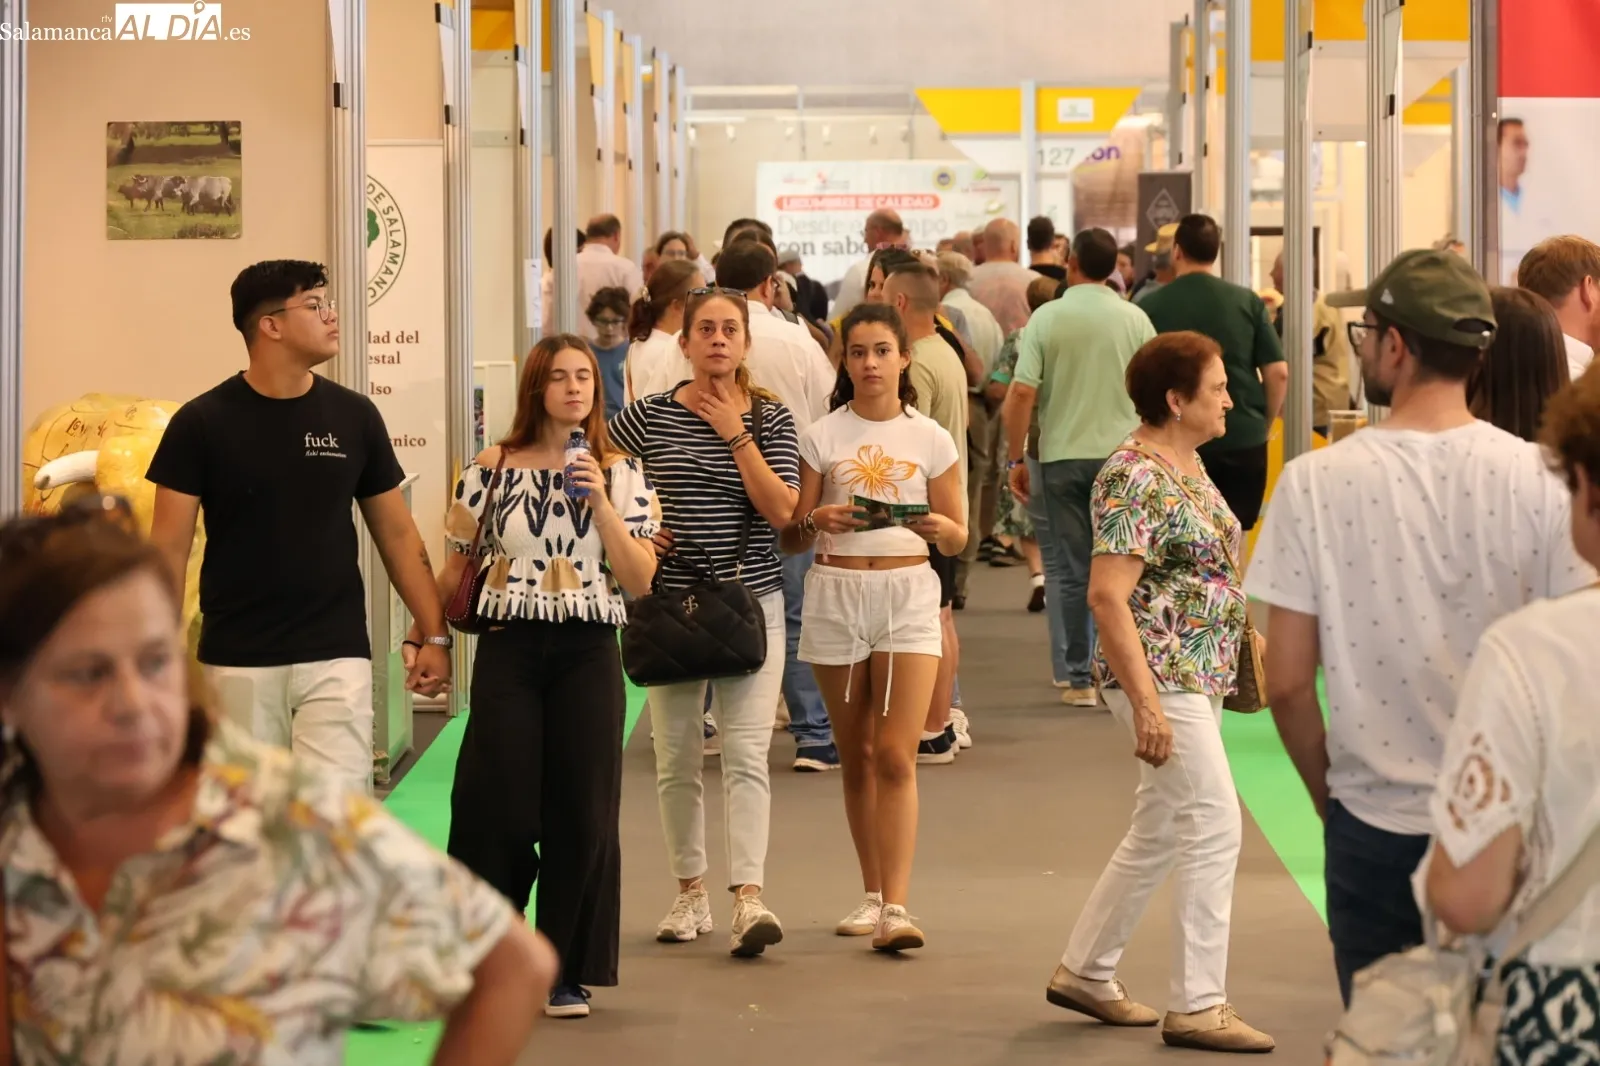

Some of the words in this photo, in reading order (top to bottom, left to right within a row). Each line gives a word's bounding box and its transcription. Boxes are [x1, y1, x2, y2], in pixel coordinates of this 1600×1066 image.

[1036, 147, 1076, 166] 127
[1087, 145, 1121, 162] on
[876, 195, 933, 209] CALIDAD
[778, 215, 844, 235] Desde
[368, 205, 403, 299] SALAMANC
[778, 241, 815, 256] con
[822, 236, 868, 256] sabo
[395, 330, 420, 344] del
[368, 351, 401, 365] estal
[369, 382, 392, 395] lso
[304, 432, 339, 448] fuck
[391, 434, 427, 448] nico
